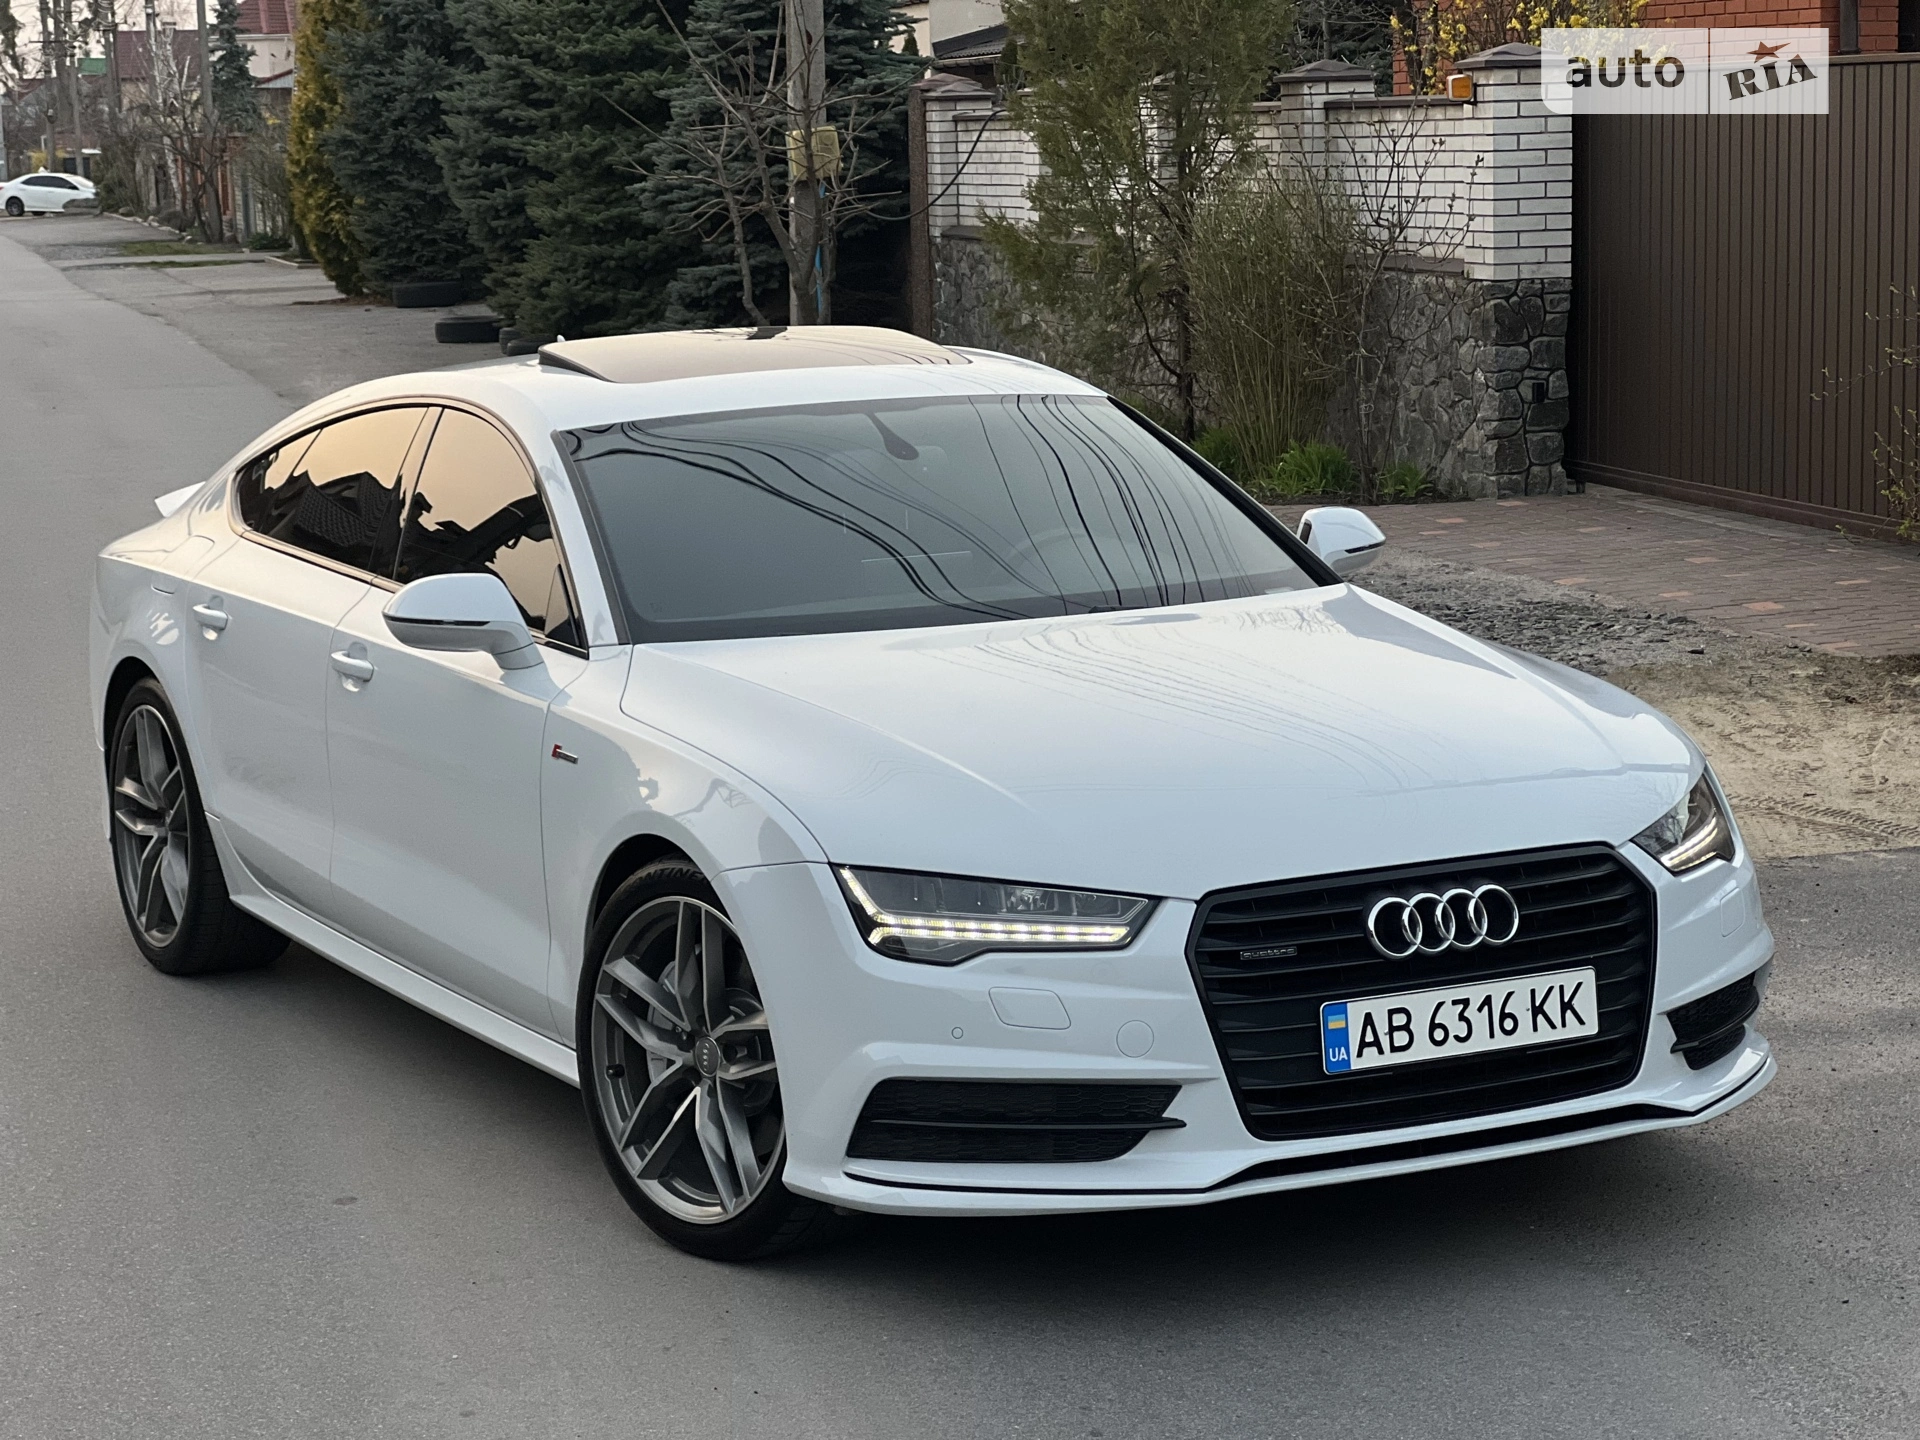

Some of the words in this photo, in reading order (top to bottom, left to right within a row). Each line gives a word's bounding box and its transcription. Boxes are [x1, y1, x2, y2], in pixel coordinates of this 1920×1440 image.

[1356, 1006, 1415, 1058] AB
[1428, 991, 1519, 1047] 6316
[1530, 981, 1586, 1033] KK
[1329, 1047, 1348, 1062] UA
